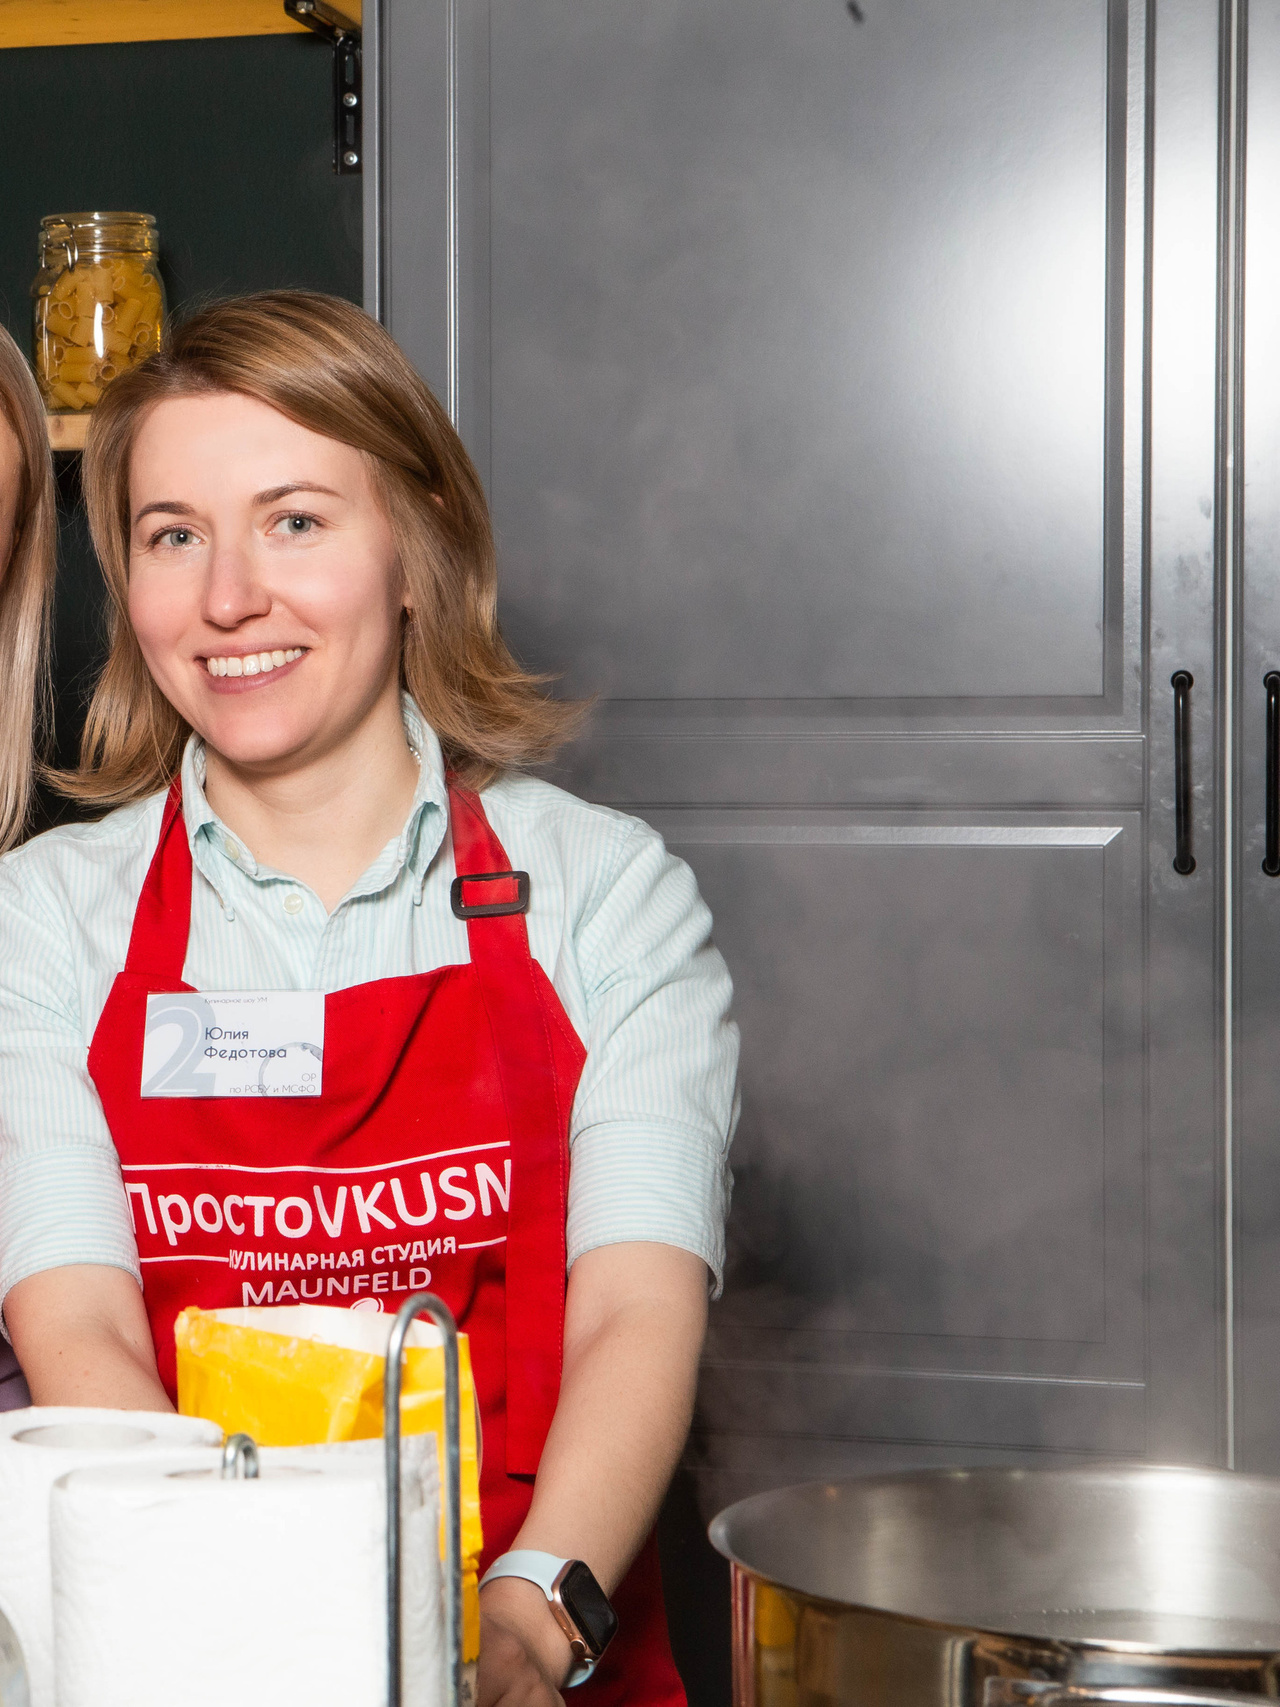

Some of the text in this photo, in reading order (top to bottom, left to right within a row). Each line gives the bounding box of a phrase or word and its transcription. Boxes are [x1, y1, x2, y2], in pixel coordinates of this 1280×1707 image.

[205, 1027, 249, 1040] Юлия
[204, 1046, 287, 1061] Федотова
[229, 1086, 242, 1094] по
[281, 1084, 316, 1094] МСФО
[229, 1236, 456, 1271] КУЛИНАРНАЯ СТУДИЯ
[242, 1267, 432, 1307] MAUNFELD
